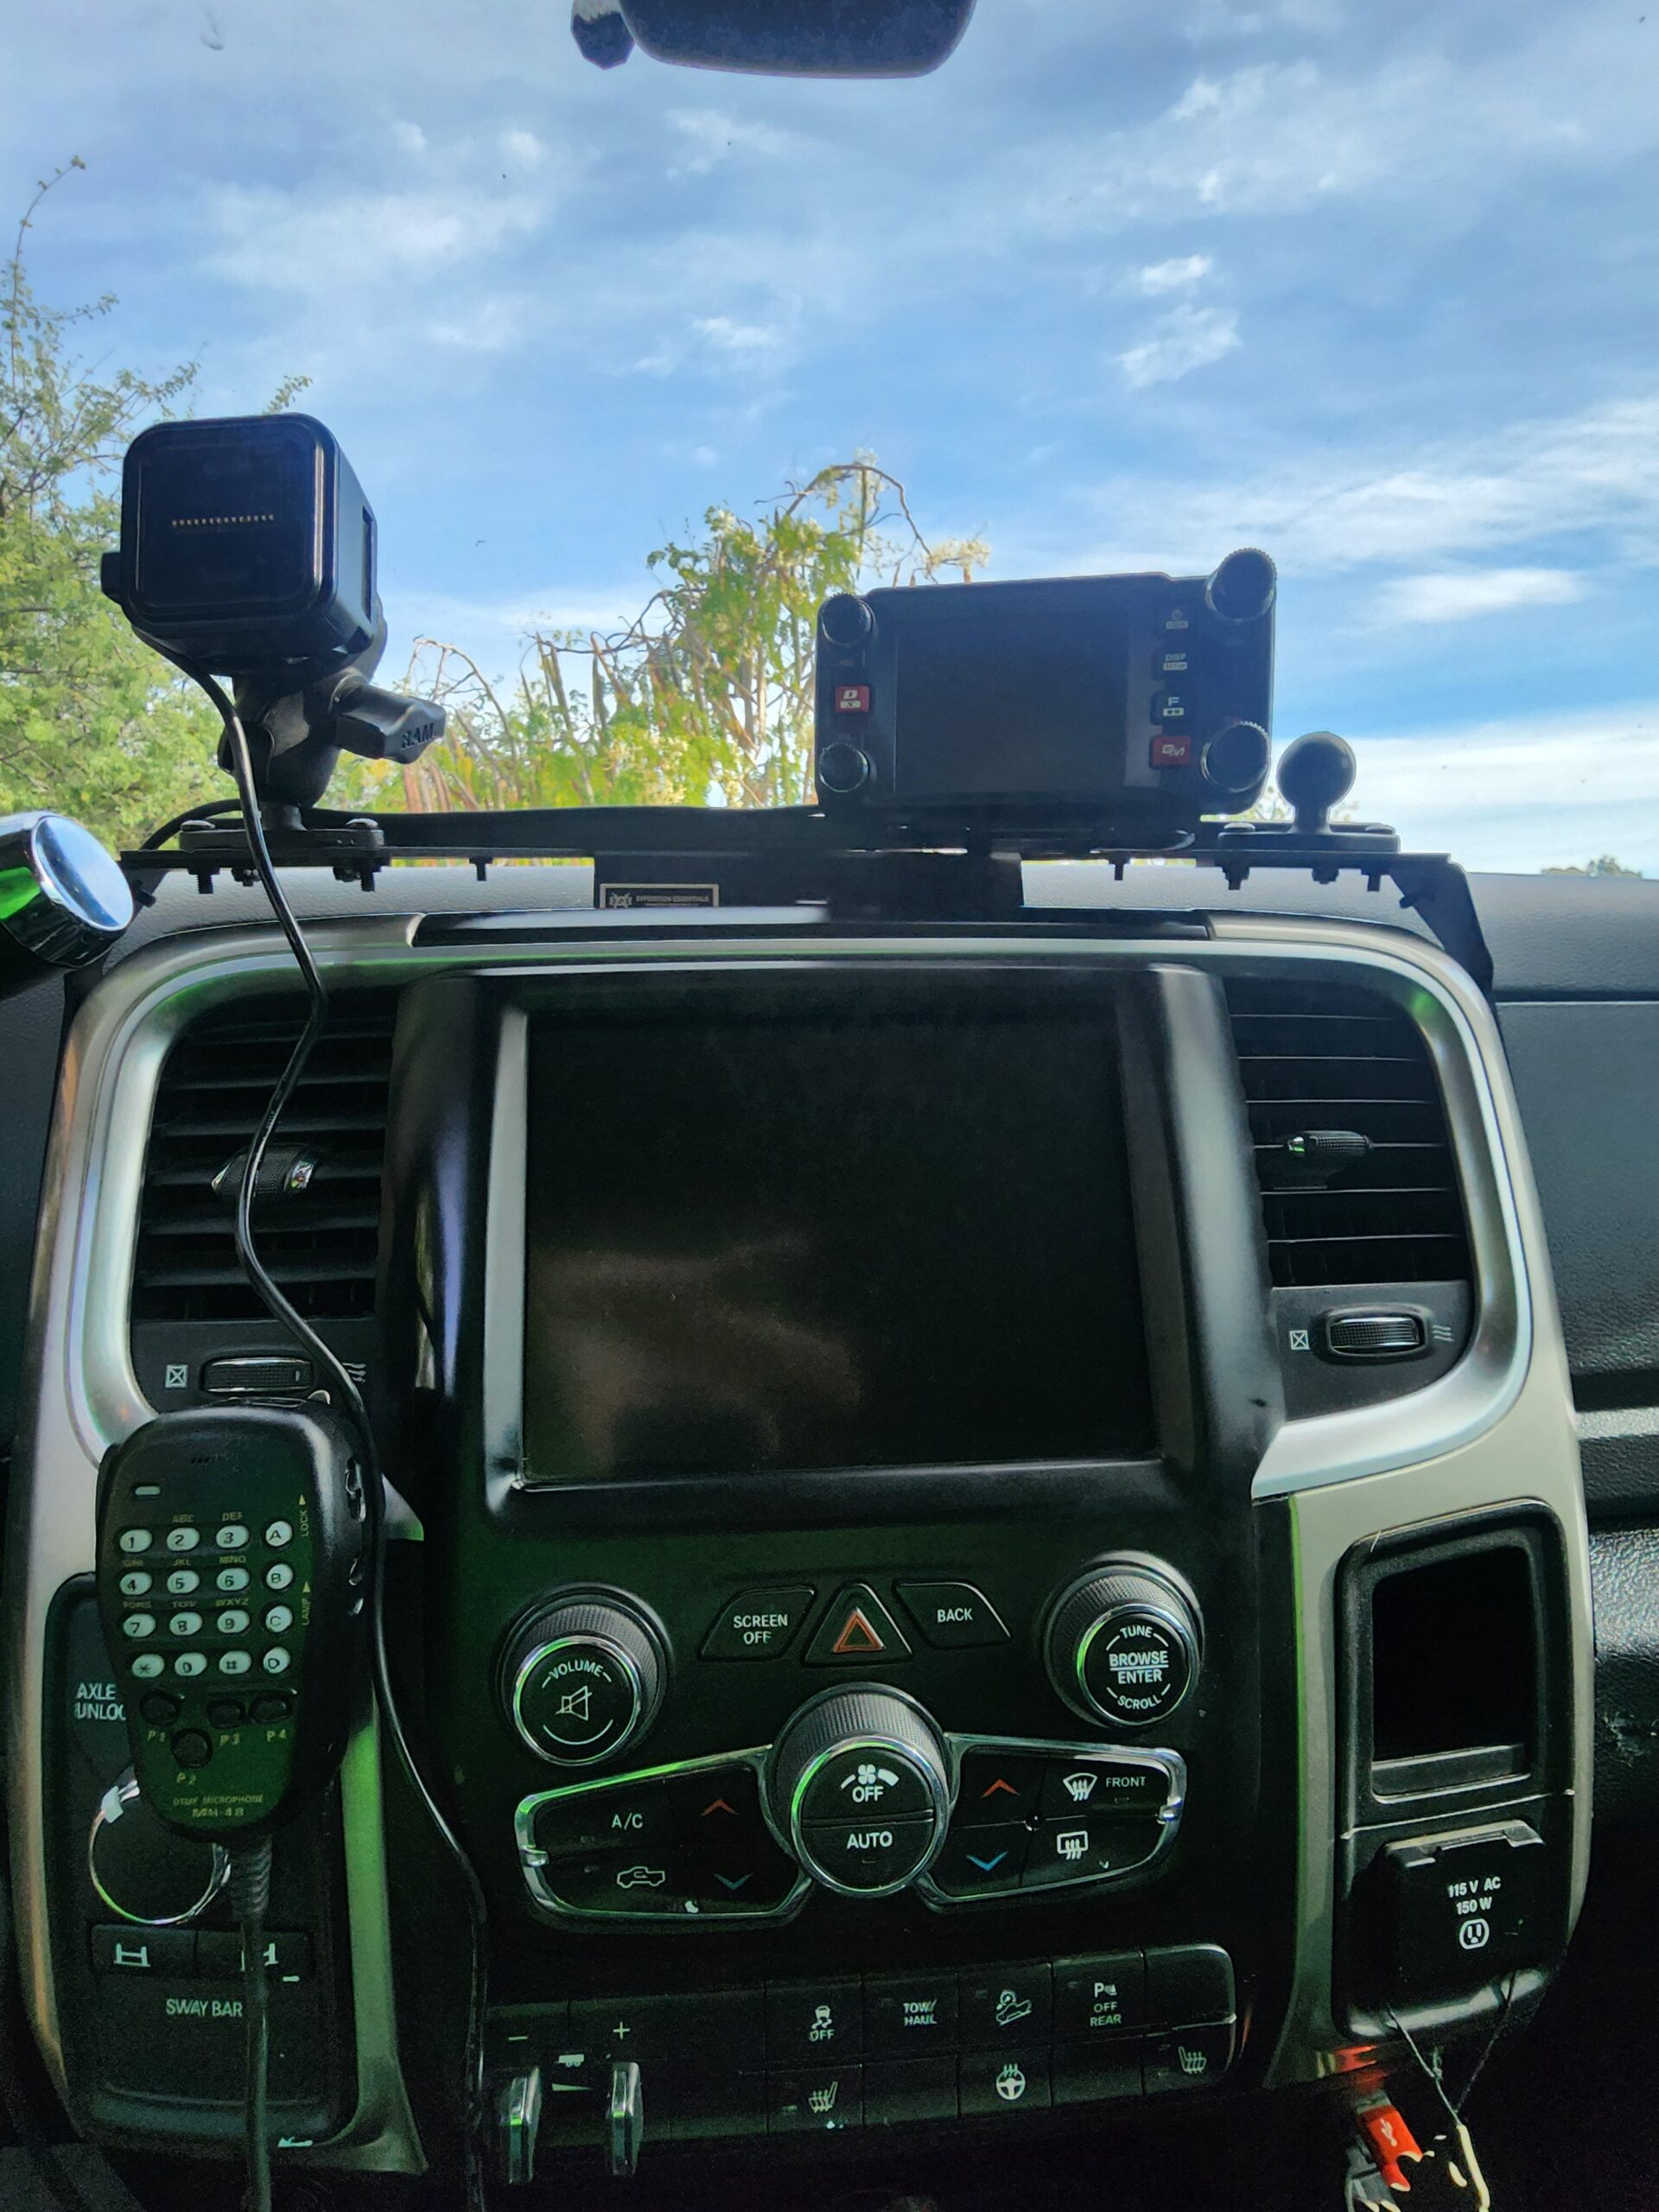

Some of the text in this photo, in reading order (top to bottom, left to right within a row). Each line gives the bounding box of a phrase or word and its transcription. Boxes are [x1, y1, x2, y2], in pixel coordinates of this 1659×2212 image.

[1167, 696, 1179, 707] F
[222, 1512, 243, 1521] DEF
[300, 1509, 308, 1536] LOCK
[174, 1535, 185, 1546] 2
[223, 1532, 234, 1544] 3
[269, 1529, 282, 1541] A
[129, 1536, 135, 1548] 1
[175, 1578, 185, 1590] 5
[224, 1575, 234, 1587] 6
[271, 1573, 282, 1584] B
[127, 1580, 136, 1591] 4
[216, 1598, 249, 1606] WXYZ
[302, 1599, 311, 1625] LAMP
[937, 1607, 973, 1623] BACK
[130, 1622, 140, 1633] 7
[225, 1618, 235, 1630] 9
[270, 1616, 281, 1626] C
[734, 1614, 788, 1629] SCREEN
[743, 1630, 772, 1644] OFF
[1120, 1624, 1154, 1638] TUNE
[268, 1658, 280, 1669] D
[1109, 1650, 1168, 1668] BROWSE
[549, 1659, 604, 1680] VOLUME
[1117, 1669, 1162, 1684] ENTER
[76, 1681, 116, 1700] AXLE
[1117, 1694, 1161, 1710] SCROLL
[73, 1701, 127, 1720] UNLOC
[147, 1729, 166, 1743] P1
[219, 1732, 240, 1746] P3
[266, 1729, 288, 1742] P4
[176, 1772, 197, 1785] P2
[1106, 1776, 1147, 1788] FRONT
[202, 1794, 264, 1805] MICROPHONE
[851, 1785, 884, 1803] OFF
[611, 1813, 644, 1830] A/C
[846, 1830, 893, 1850] AUTO
[1447, 1876, 1502, 1898] 115 V AC
[1456, 1896, 1493, 1916] 150 W
[166, 1999, 243, 2018] SWAY BAR
[1094, 2000, 1118, 2013] OFF
[904, 2013, 938, 2026] HAUL
[1090, 2014, 1122, 2027] REAR
[808, 2028, 836, 2042] OFF
